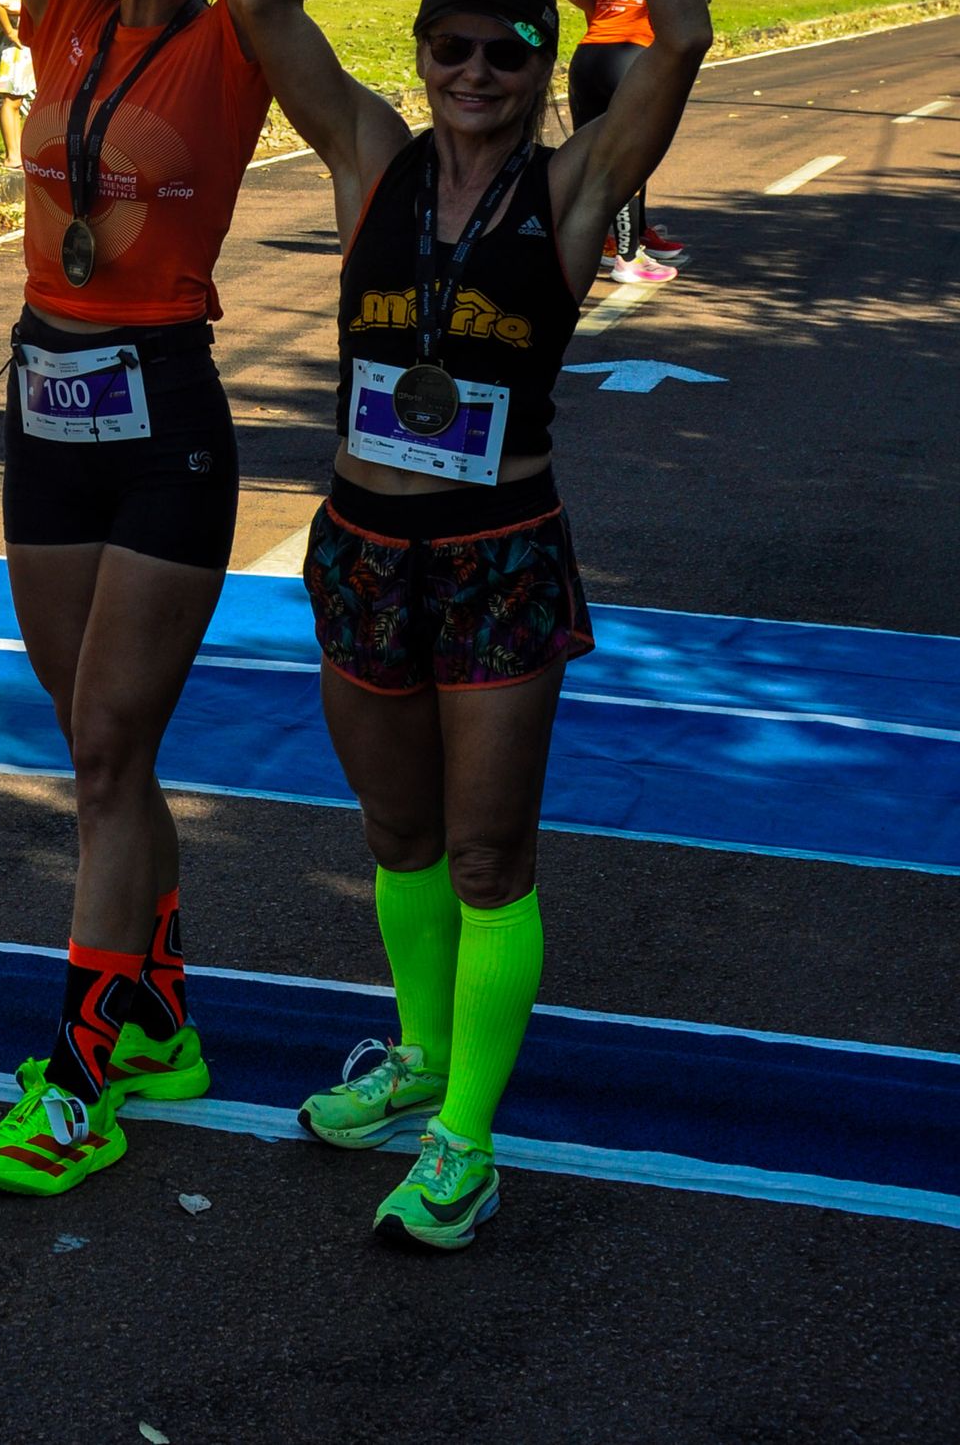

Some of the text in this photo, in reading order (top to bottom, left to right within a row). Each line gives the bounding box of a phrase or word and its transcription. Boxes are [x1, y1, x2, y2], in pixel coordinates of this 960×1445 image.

[32, 165, 66, 181] Porto
[157, 186, 194, 200] Sinop
[372, 372, 385, 384] 10K
[42, 378, 91, 409] 100
